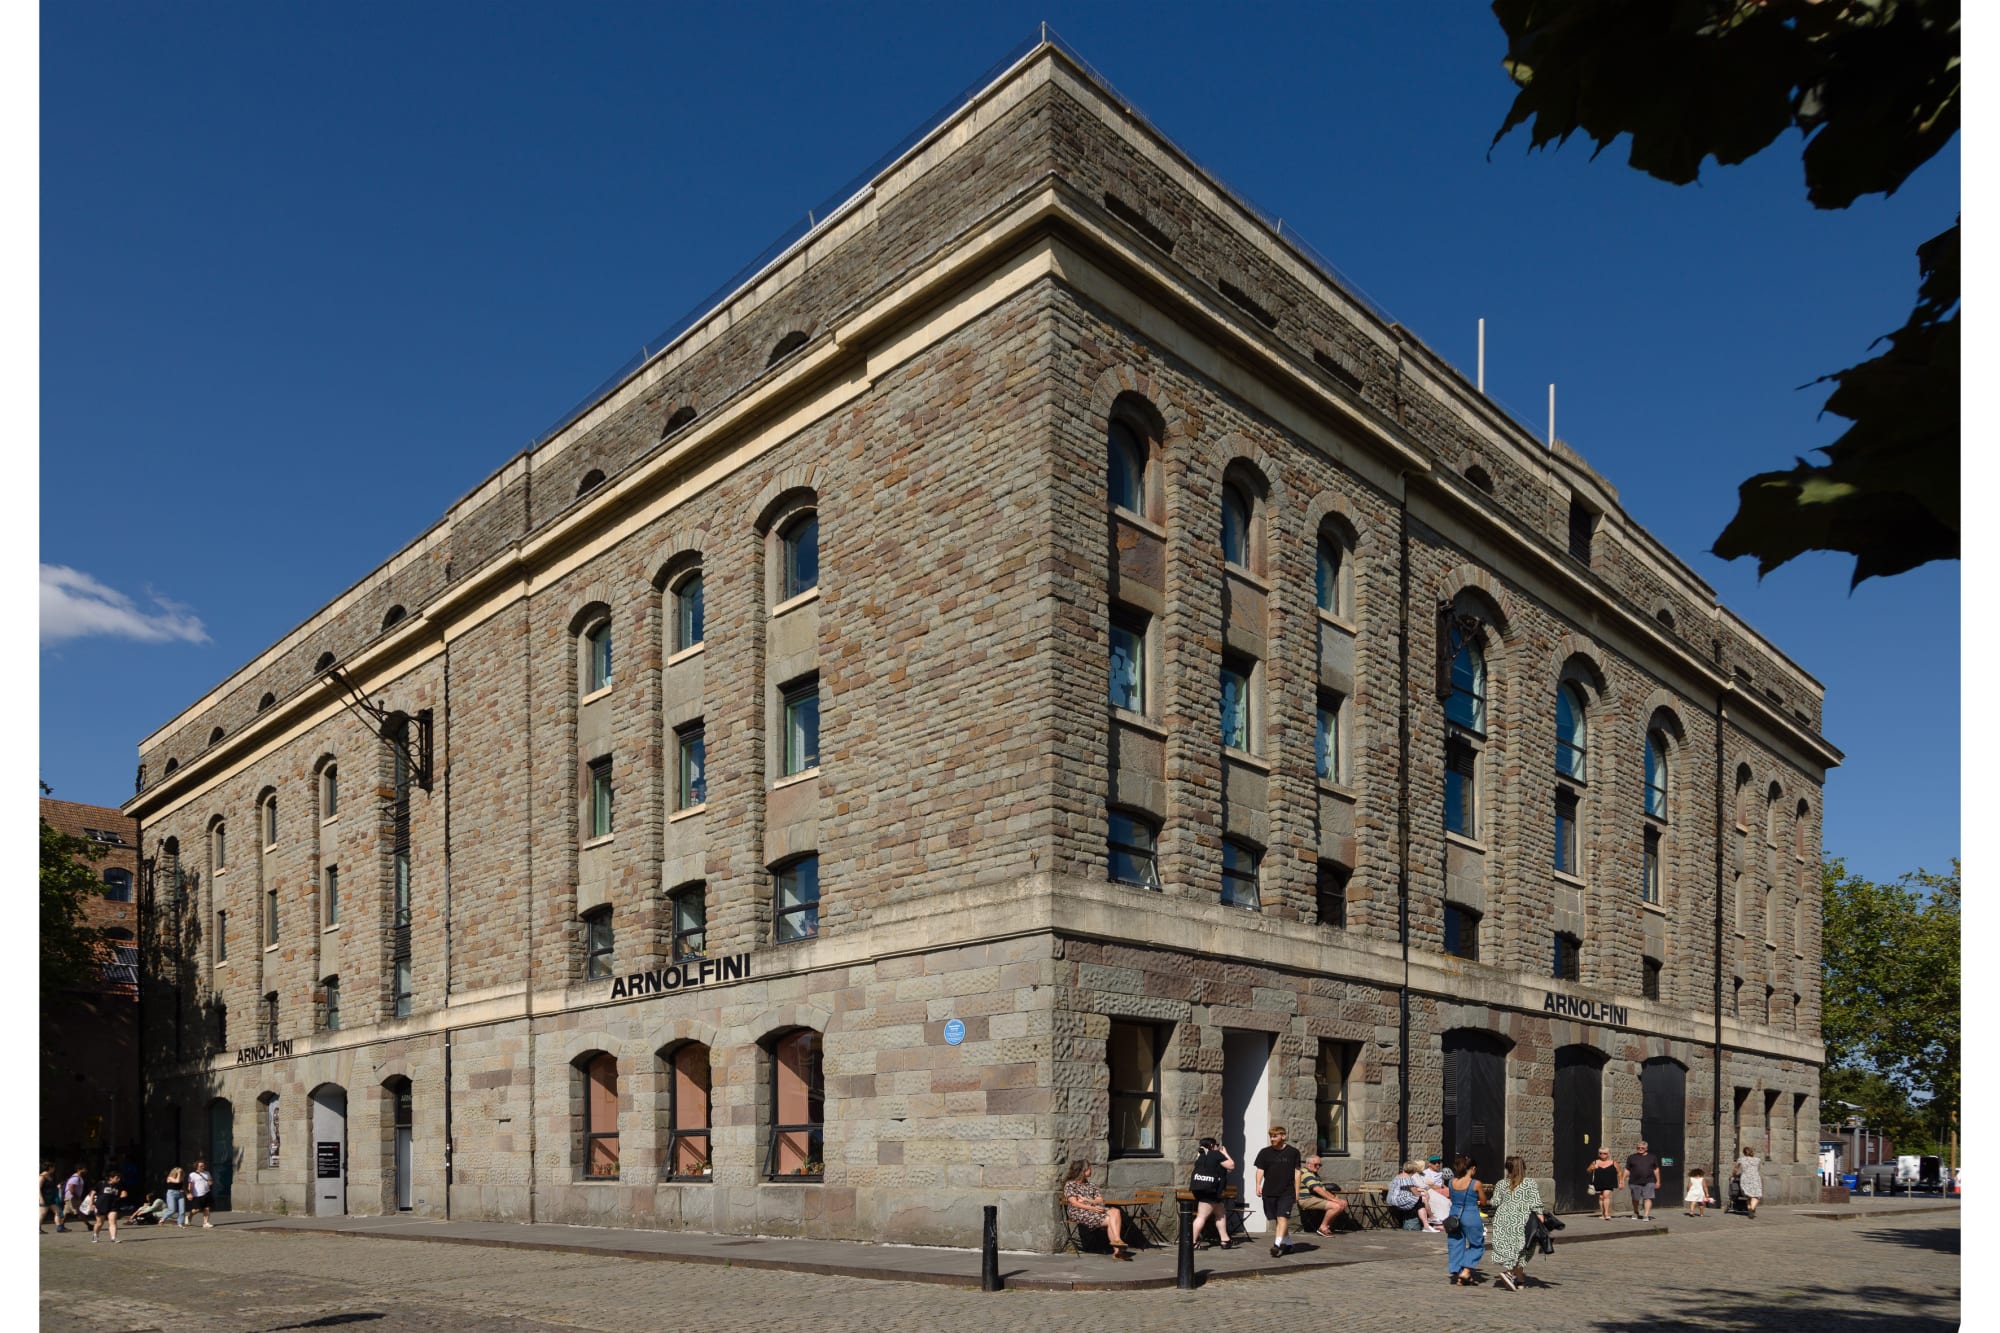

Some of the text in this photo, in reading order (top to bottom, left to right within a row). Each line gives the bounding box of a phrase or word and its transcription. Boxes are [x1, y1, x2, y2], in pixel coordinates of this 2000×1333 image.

[611, 953, 750, 999] ARNOLFINI
[1544, 992, 1628, 1025] ARNOLFINI
[237, 1039, 293, 1064] ARNOLFINI
[1194, 1173, 1215, 1182] foam
